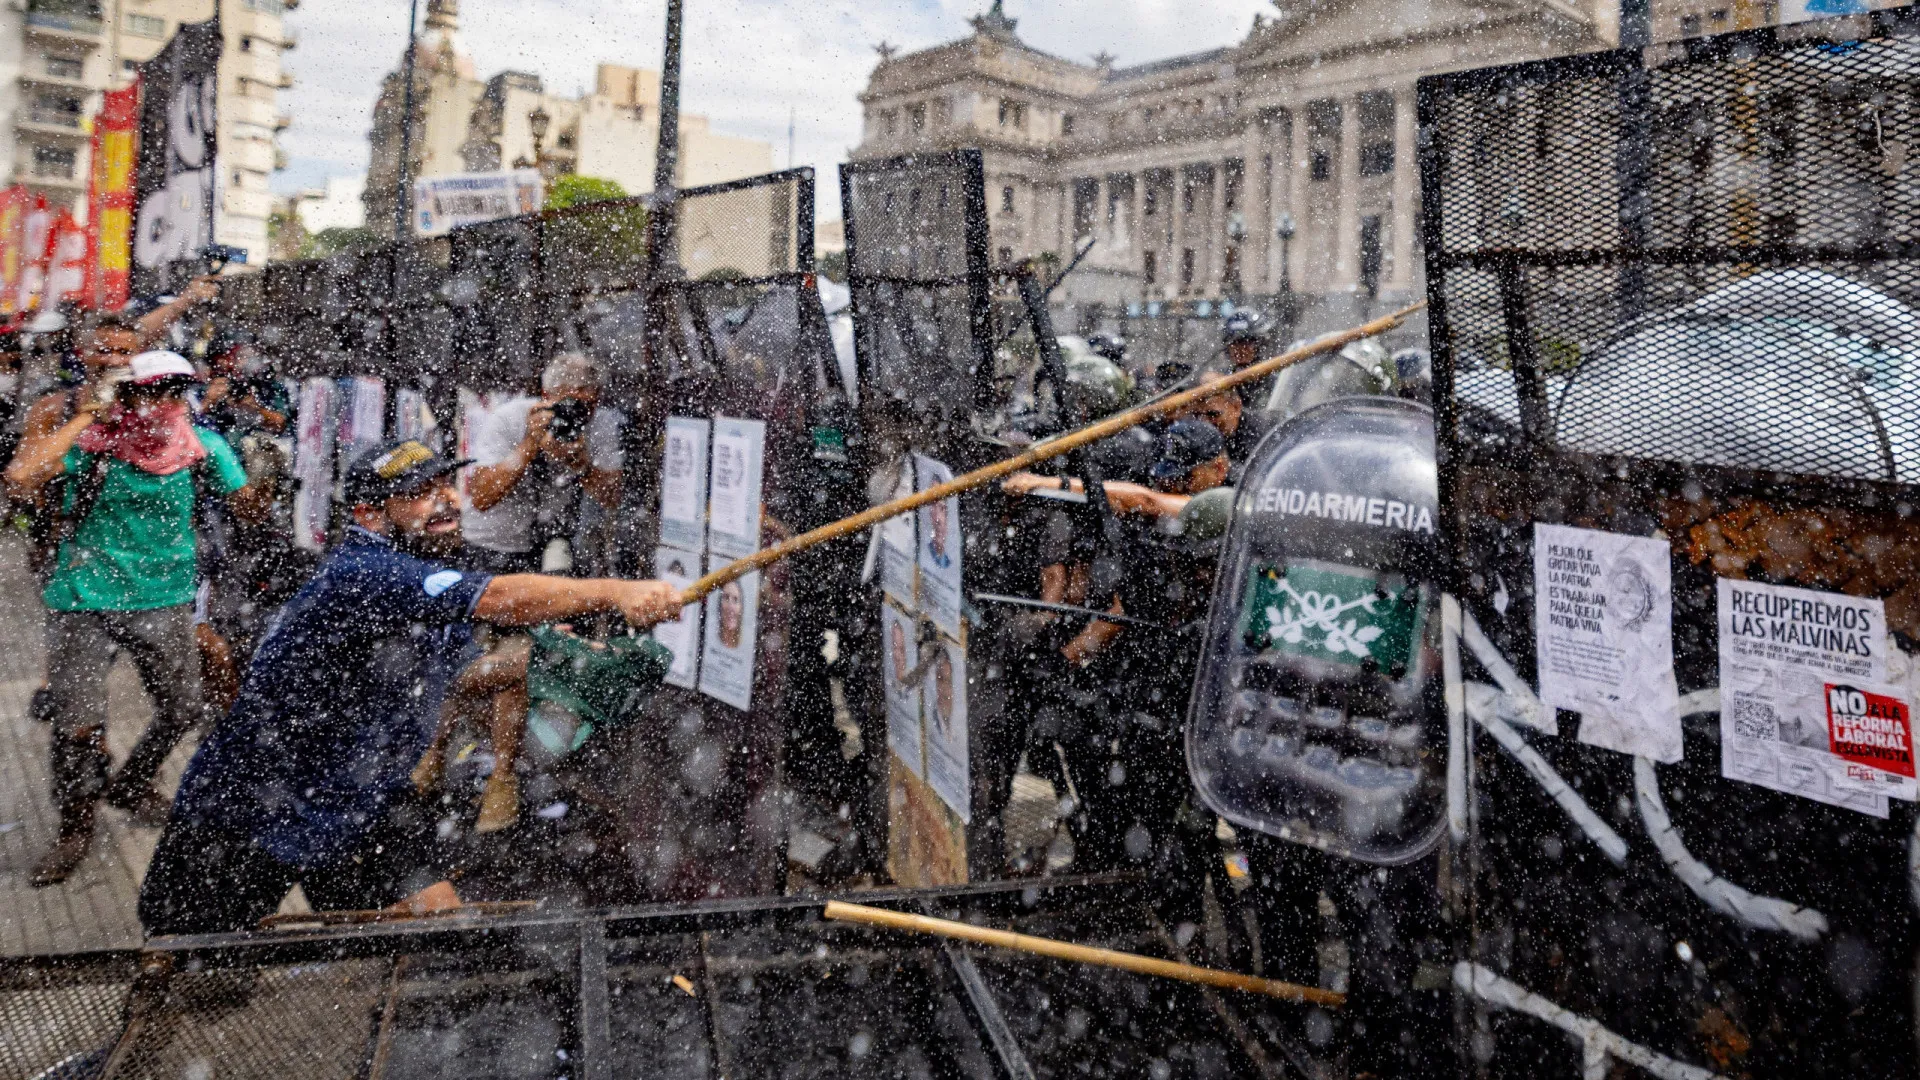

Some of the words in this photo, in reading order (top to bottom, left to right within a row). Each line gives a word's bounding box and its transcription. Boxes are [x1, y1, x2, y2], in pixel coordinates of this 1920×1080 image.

[1577, 547, 1593, 560] QUE
[1580, 561, 1601, 576] VIVA
[1549, 571, 1560, 583] LA
[1561, 573, 1592, 588] PATRIA
[1550, 586, 1559, 598] ES
[1561, 588, 1607, 607] TRABAJAR
[1550, 600, 1572, 614] PARA
[1574, 604, 1590, 618] QUE
[1591, 607, 1604, 620] LA
[1732, 590, 1871, 632] RECUPEREMOS
[1550, 614, 1579, 629] PATRIA
[1581, 620, 1602, 634] VIVA
[1732, 614, 1765, 639] LAS
[1771, 621, 1872, 658] MALVINAS
[1829, 689, 1867, 716] NO
[1870, 705, 1880, 717] A
[1882, 705, 1902, 719] LA
[1832, 714, 1906, 736] REFORMA
[1834, 726, 1908, 751] LABORAL
[1835, 742, 1911, 764] ESCLAVISTA
